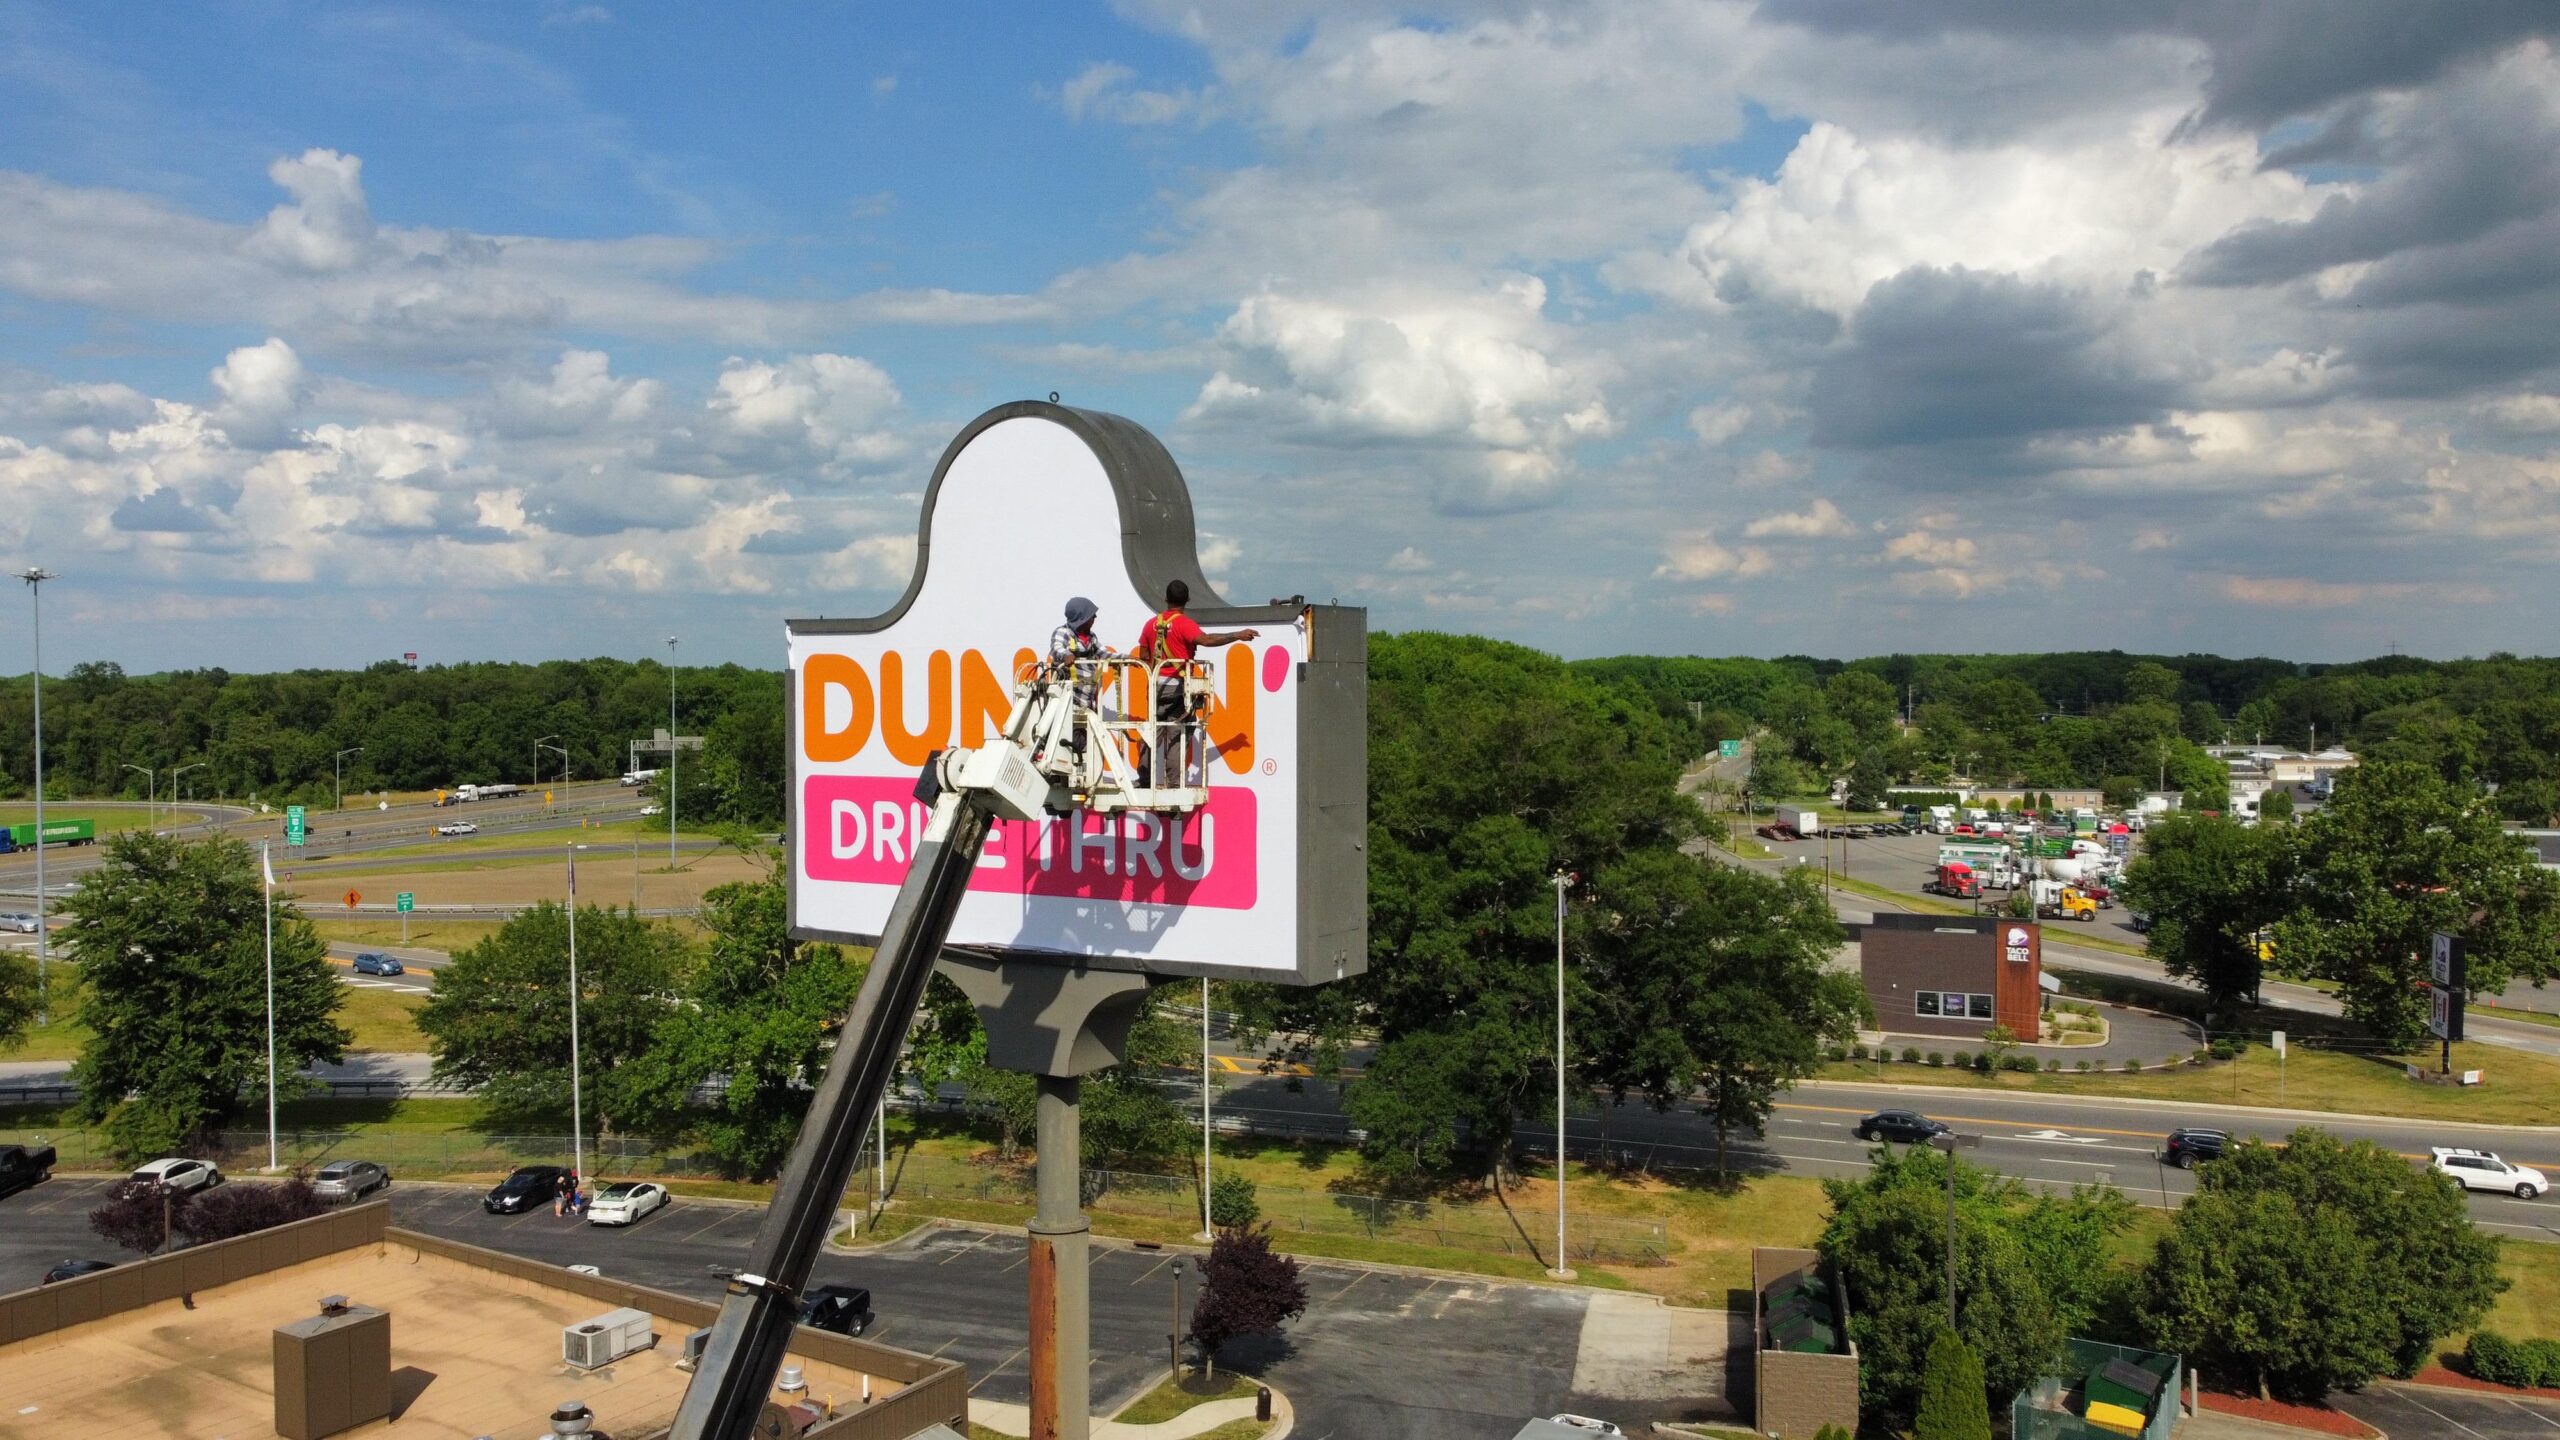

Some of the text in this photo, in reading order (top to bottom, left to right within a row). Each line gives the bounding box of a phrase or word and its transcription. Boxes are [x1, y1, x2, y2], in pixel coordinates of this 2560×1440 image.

[803, 643, 1290, 775] DUNIN'
[831, 799, 1006, 869] DRI
[2005, 946, 2029, 955] TACO
[2007, 954, 2029, 962] BELL
